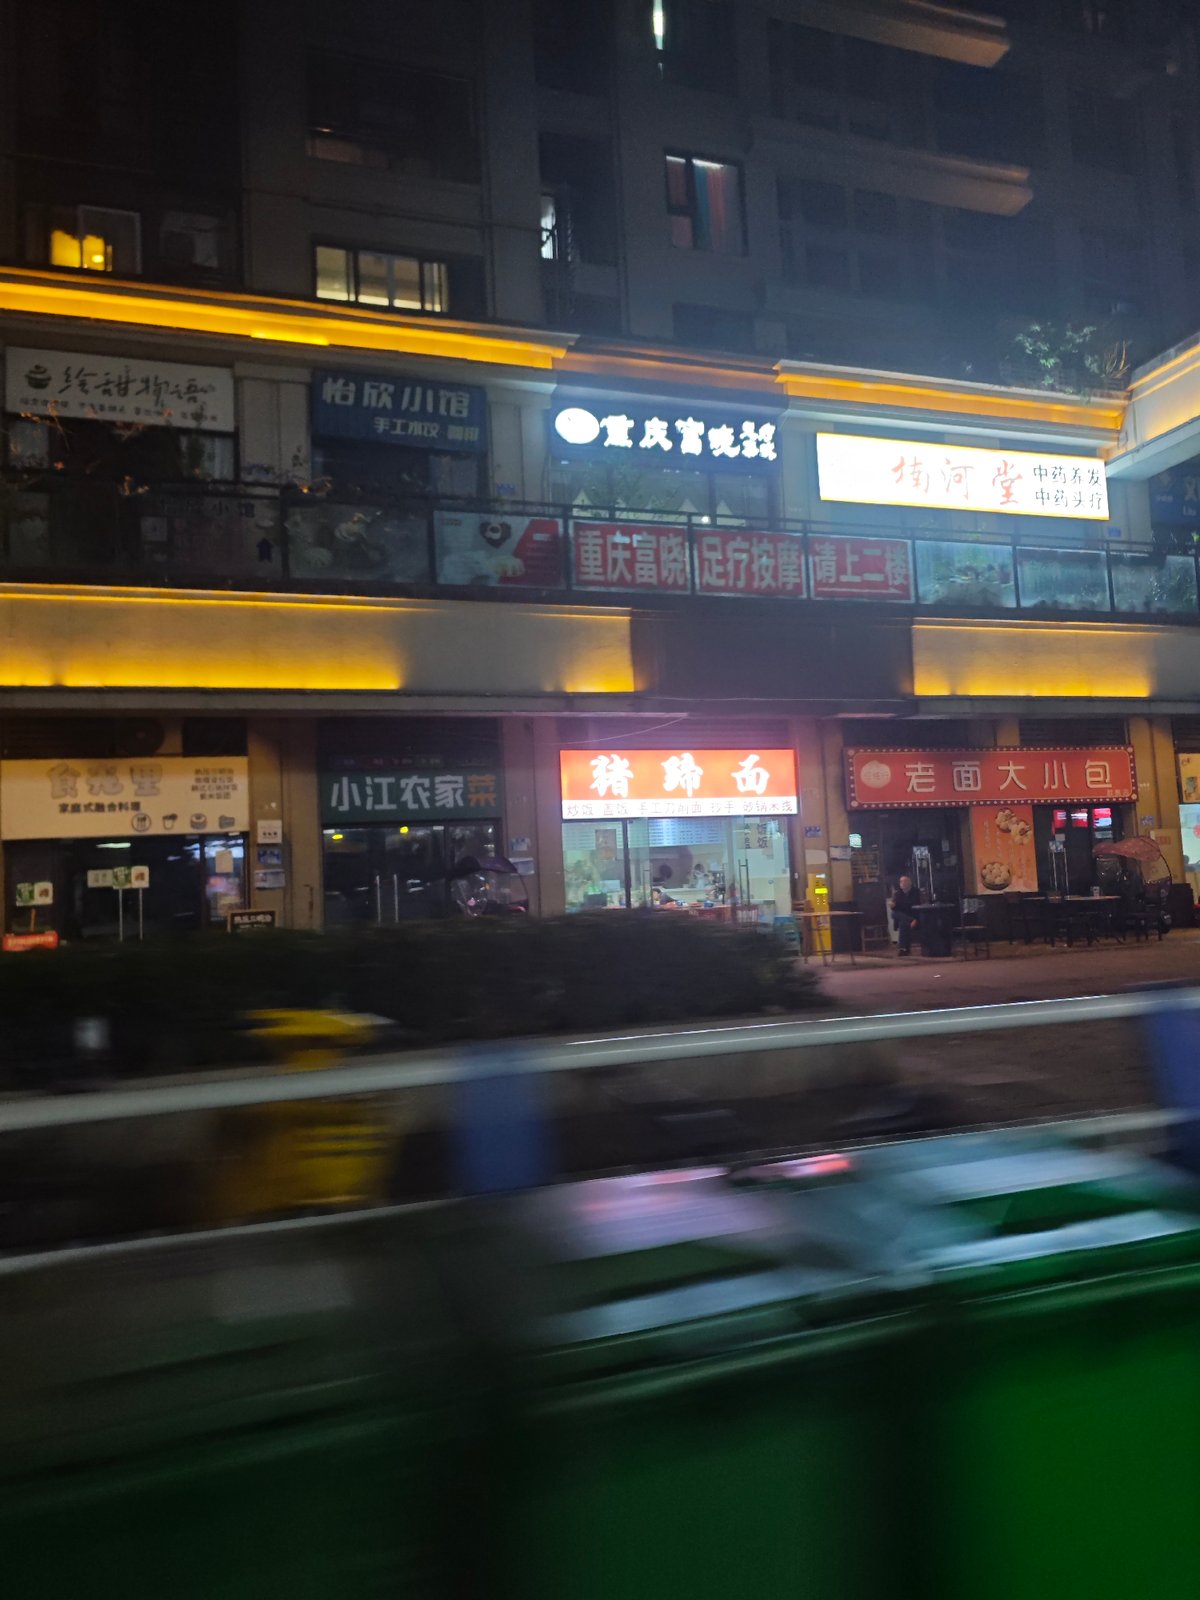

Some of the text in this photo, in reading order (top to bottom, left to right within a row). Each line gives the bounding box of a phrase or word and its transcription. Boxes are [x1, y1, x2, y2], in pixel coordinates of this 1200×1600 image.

[321, 376, 470, 418] 怡欣小馆
[1033, 464, 1102, 487] 中药养发
[1035, 487, 1103, 510] 中药头疗
[577, 529, 908, 592] 重庆富晓 足疗按摩 请上二楼
[46, 762, 164, 800] 食光里
[330, 774, 497, 812] 小江农家菜
[589, 752, 771, 798] 猪蹄面
[904, 759, 1112, 793] 老面大小包
[566, 803, 594, 817] 炒饭
[638, 801, 703, 816] 手工刀削面
